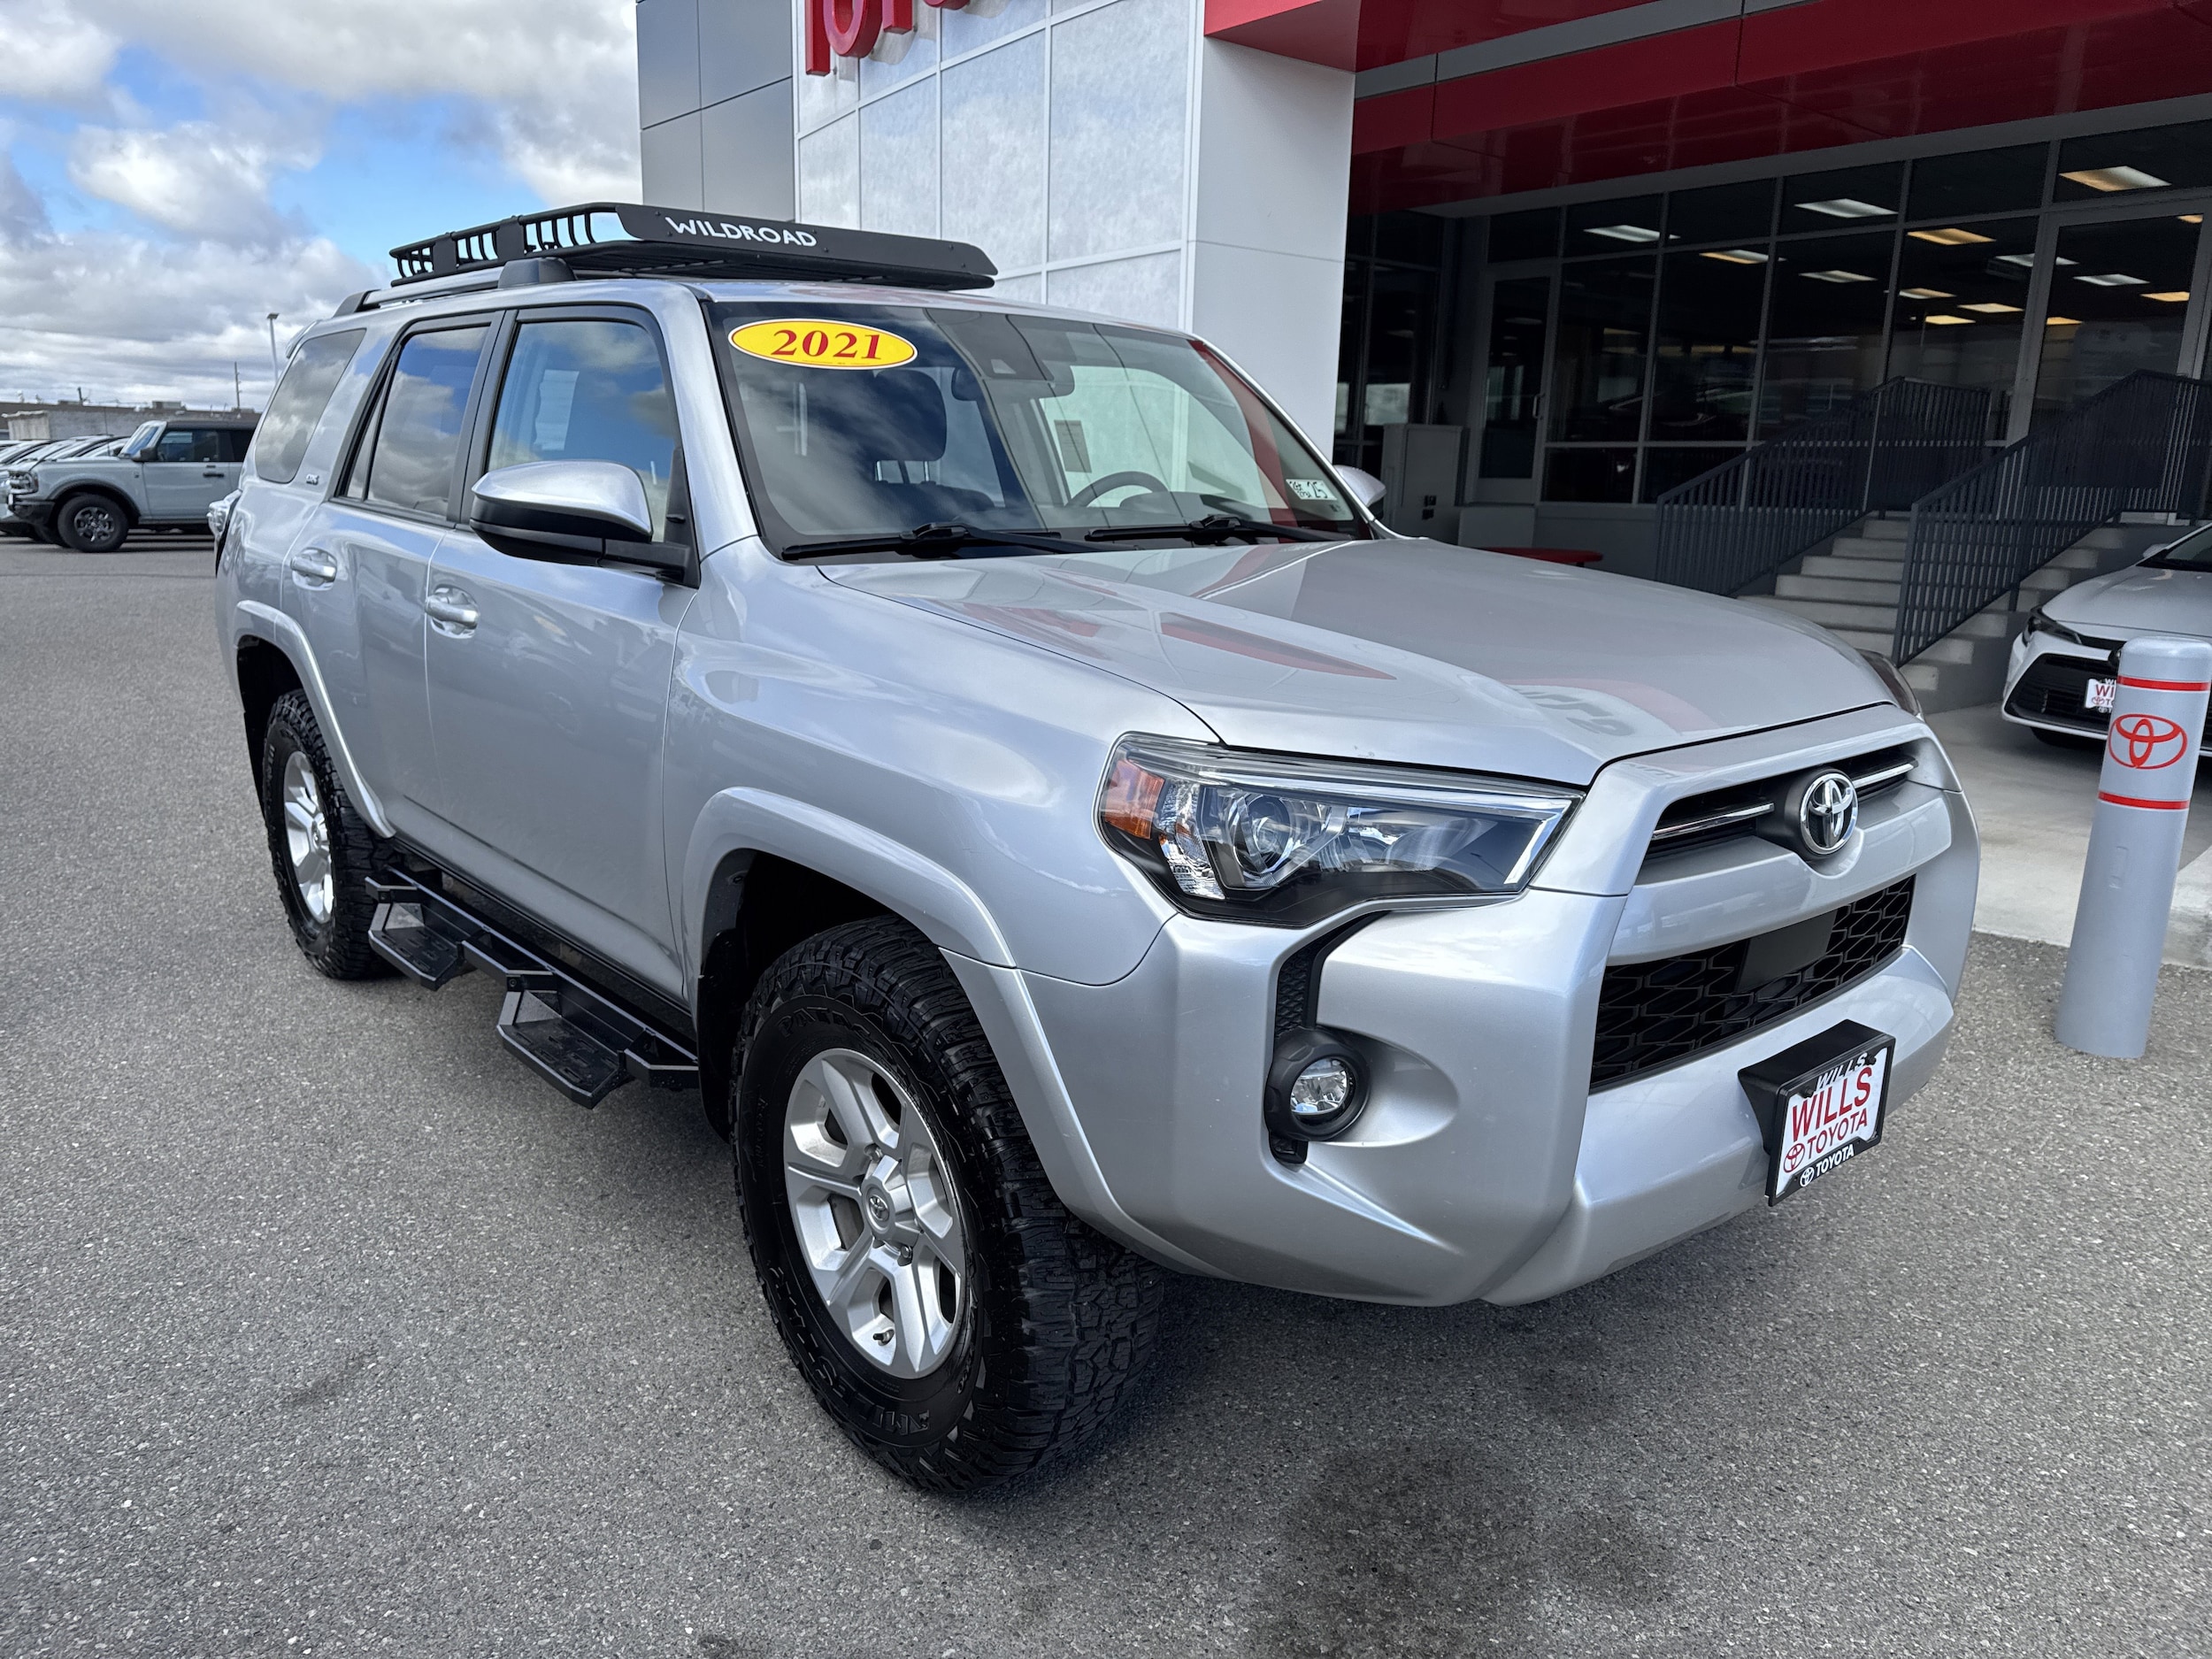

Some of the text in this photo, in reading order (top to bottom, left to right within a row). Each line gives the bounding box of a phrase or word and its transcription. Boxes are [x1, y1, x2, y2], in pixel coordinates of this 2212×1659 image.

[665, 217, 817, 247] WILDROAD
[771, 329, 882, 360] 2021
[1816, 1052, 1868, 1089] WILLS
[1793, 1067, 1872, 1141] WILLS
[1807, 1108, 1868, 1159] TOYOTA
[1816, 1144, 1855, 1177] TOYOTA
